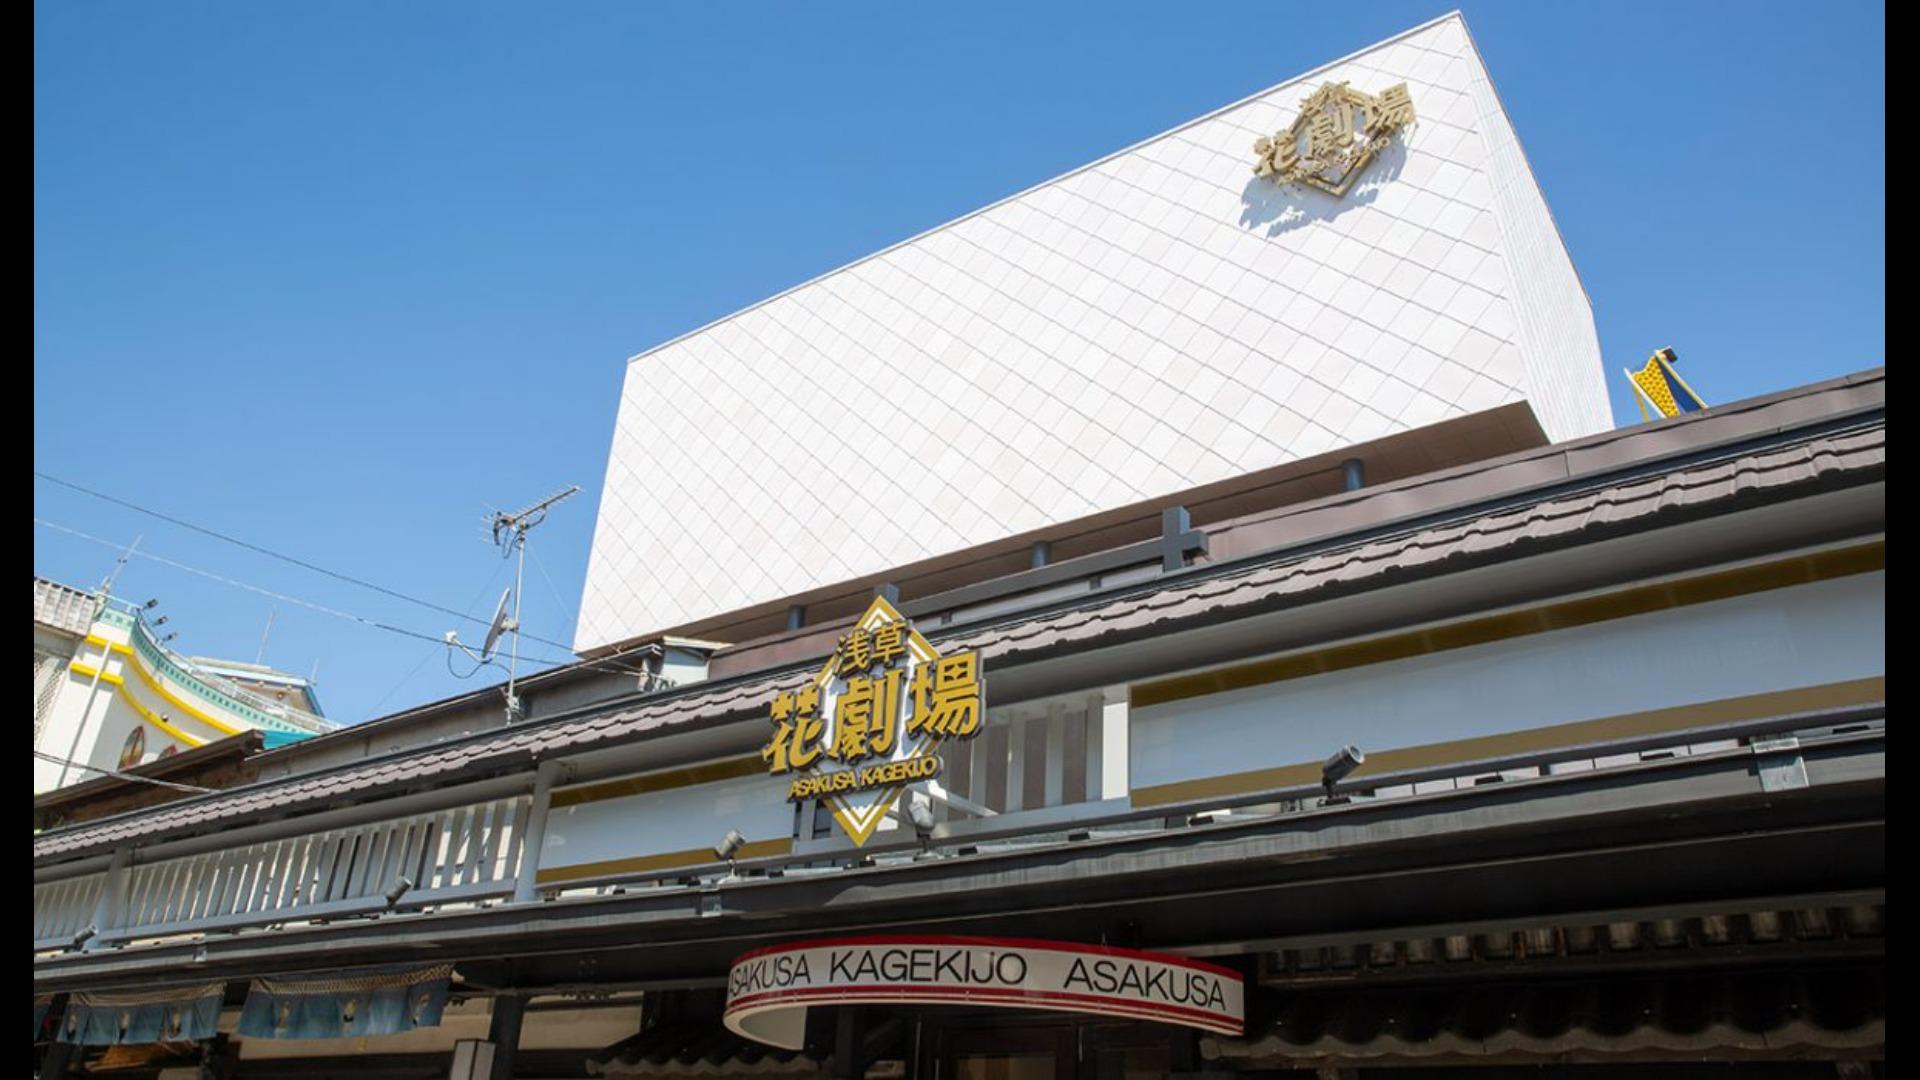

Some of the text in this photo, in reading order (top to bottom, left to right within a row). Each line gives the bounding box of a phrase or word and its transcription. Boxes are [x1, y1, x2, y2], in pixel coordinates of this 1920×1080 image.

[834, 620, 909, 675] 浅草
[763, 651, 982, 774] 花劇場
[788, 756, 938, 798] ASAKUSA KAGEKIJO
[829, 949, 1028, 985] KAGEKIJO
[1063, 957, 1226, 1011] ASAKUSA
